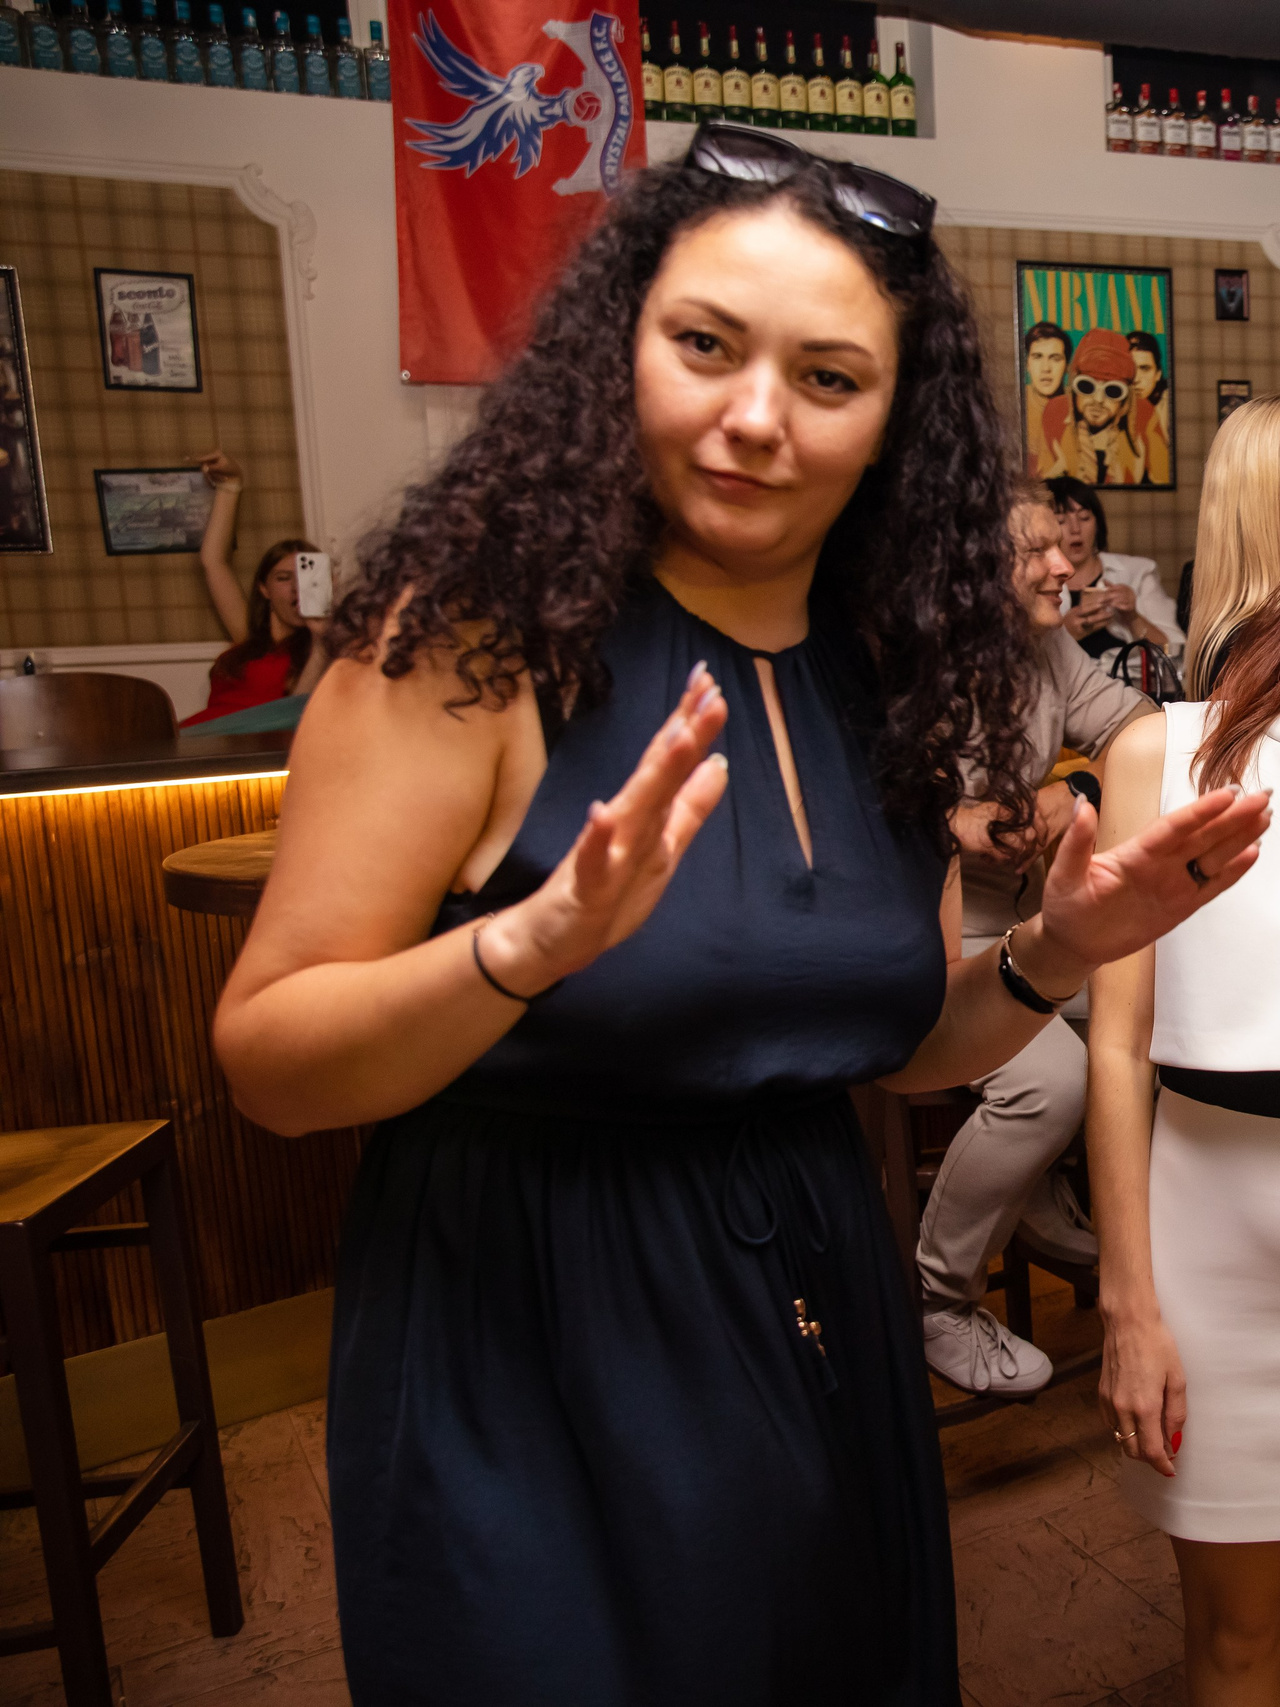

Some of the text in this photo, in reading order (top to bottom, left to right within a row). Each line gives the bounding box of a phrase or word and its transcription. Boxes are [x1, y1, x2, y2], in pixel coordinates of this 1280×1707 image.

[600, 50, 630, 116] PALACE
[604, 119, 629, 189] CRYSTAL
[1024, 268, 1165, 335] NIRVANA
